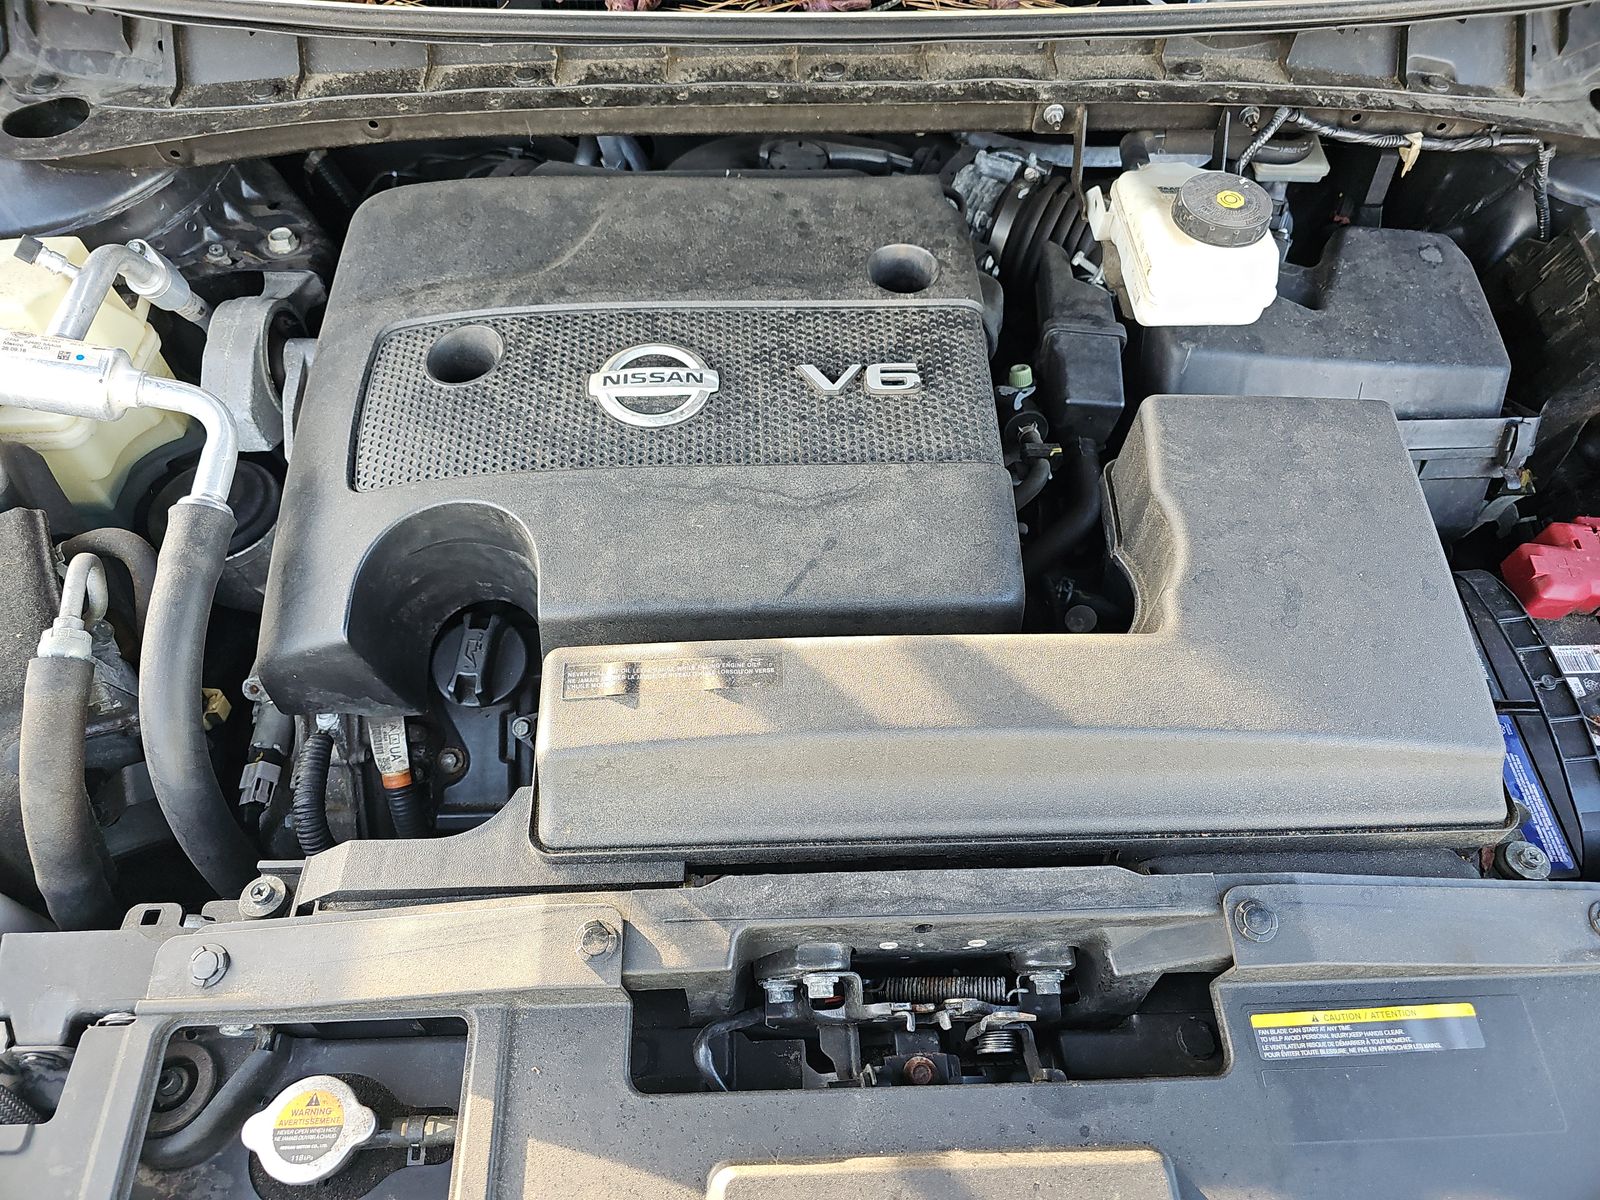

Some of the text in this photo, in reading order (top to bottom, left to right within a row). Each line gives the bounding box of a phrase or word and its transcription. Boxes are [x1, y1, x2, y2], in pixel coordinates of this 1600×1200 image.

[602, 371, 704, 387] NISSAN
[800, 362, 922, 396] V6
[1323, 1012, 1361, 1022] CAUTION
[1370, 1009, 1417, 1019] ATTENTION
[1301, 1032, 1330, 1040] PERSONAL
[1269, 1042, 1306, 1050] VENTILATEUR
[291, 1108, 332, 1117] WARNING
[278, 1117, 341, 1126] AVERTISSEMENT
